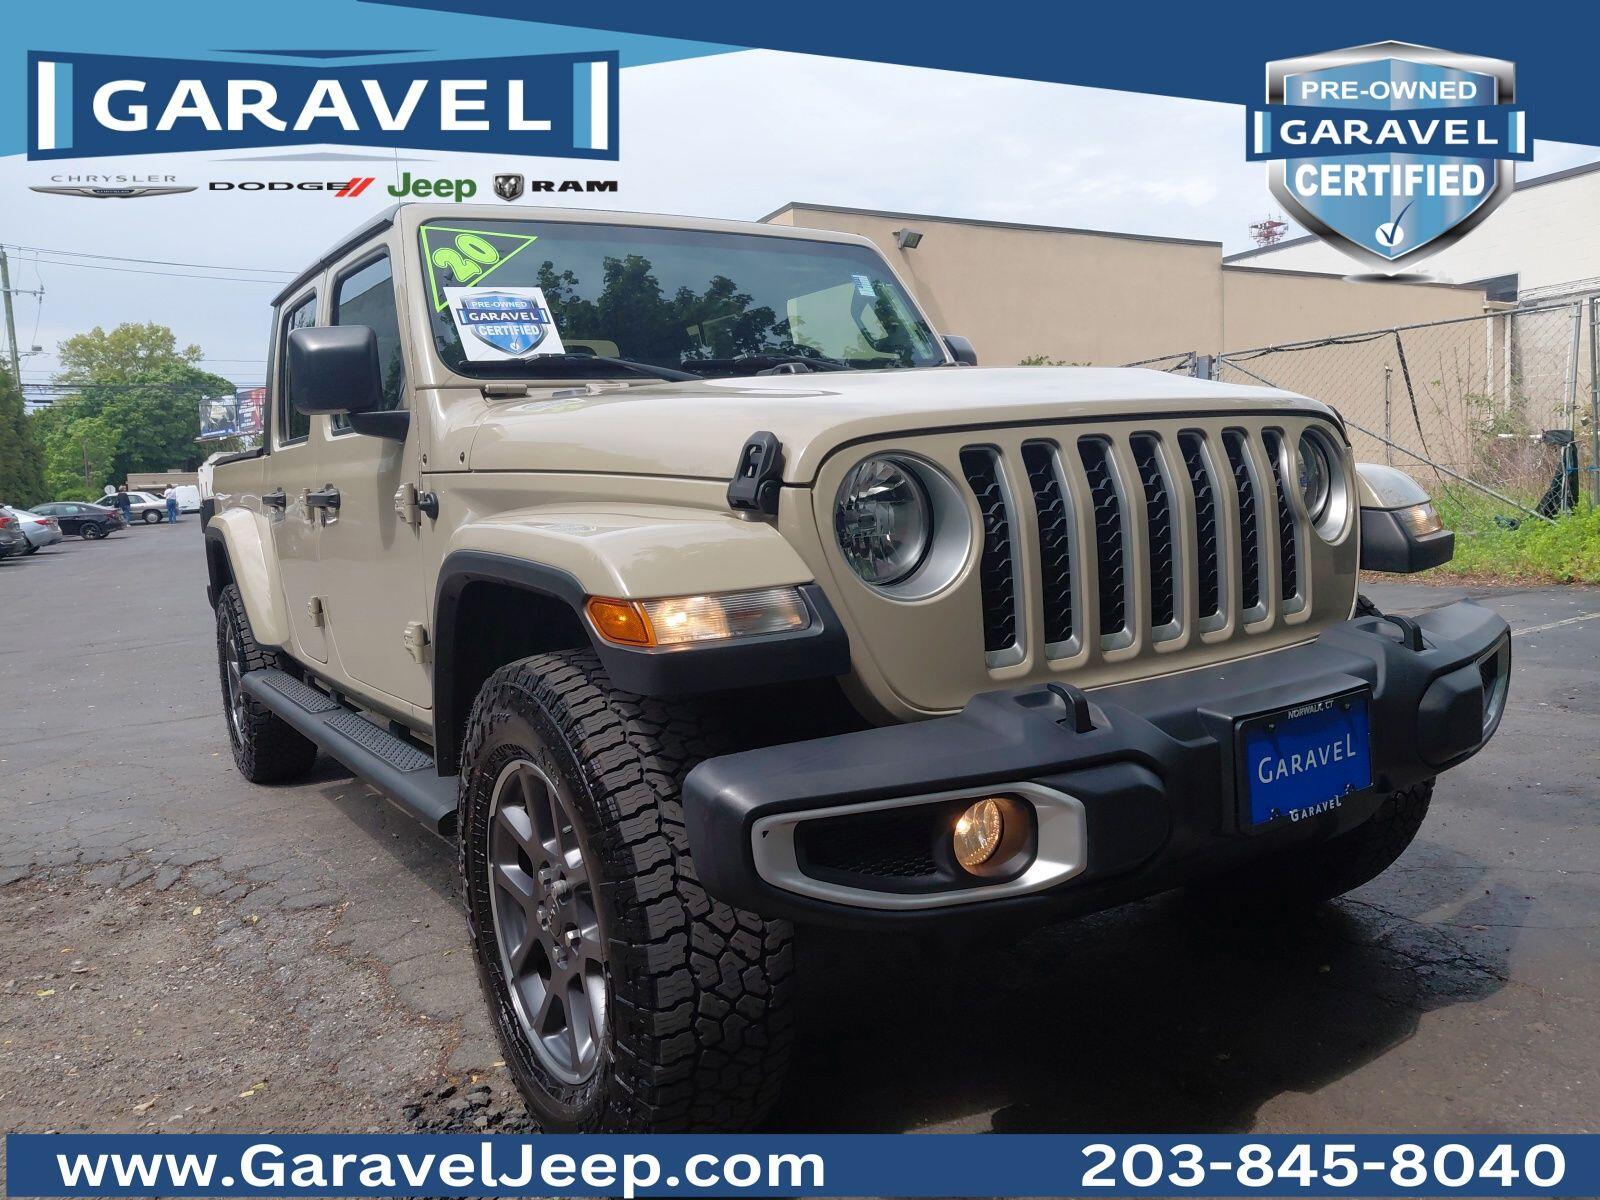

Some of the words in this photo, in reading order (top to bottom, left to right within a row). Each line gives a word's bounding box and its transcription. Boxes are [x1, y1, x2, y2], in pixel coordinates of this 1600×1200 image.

[432, 233, 500, 282] 20
[471, 301, 528, 309] PRE-OWNED
[469, 311, 539, 321] GARAVEL
[478, 324, 540, 337] CERTIFIED
[1258, 733, 1356, 784] GARAVEL
[1289, 795, 1342, 822] GARAVEL
